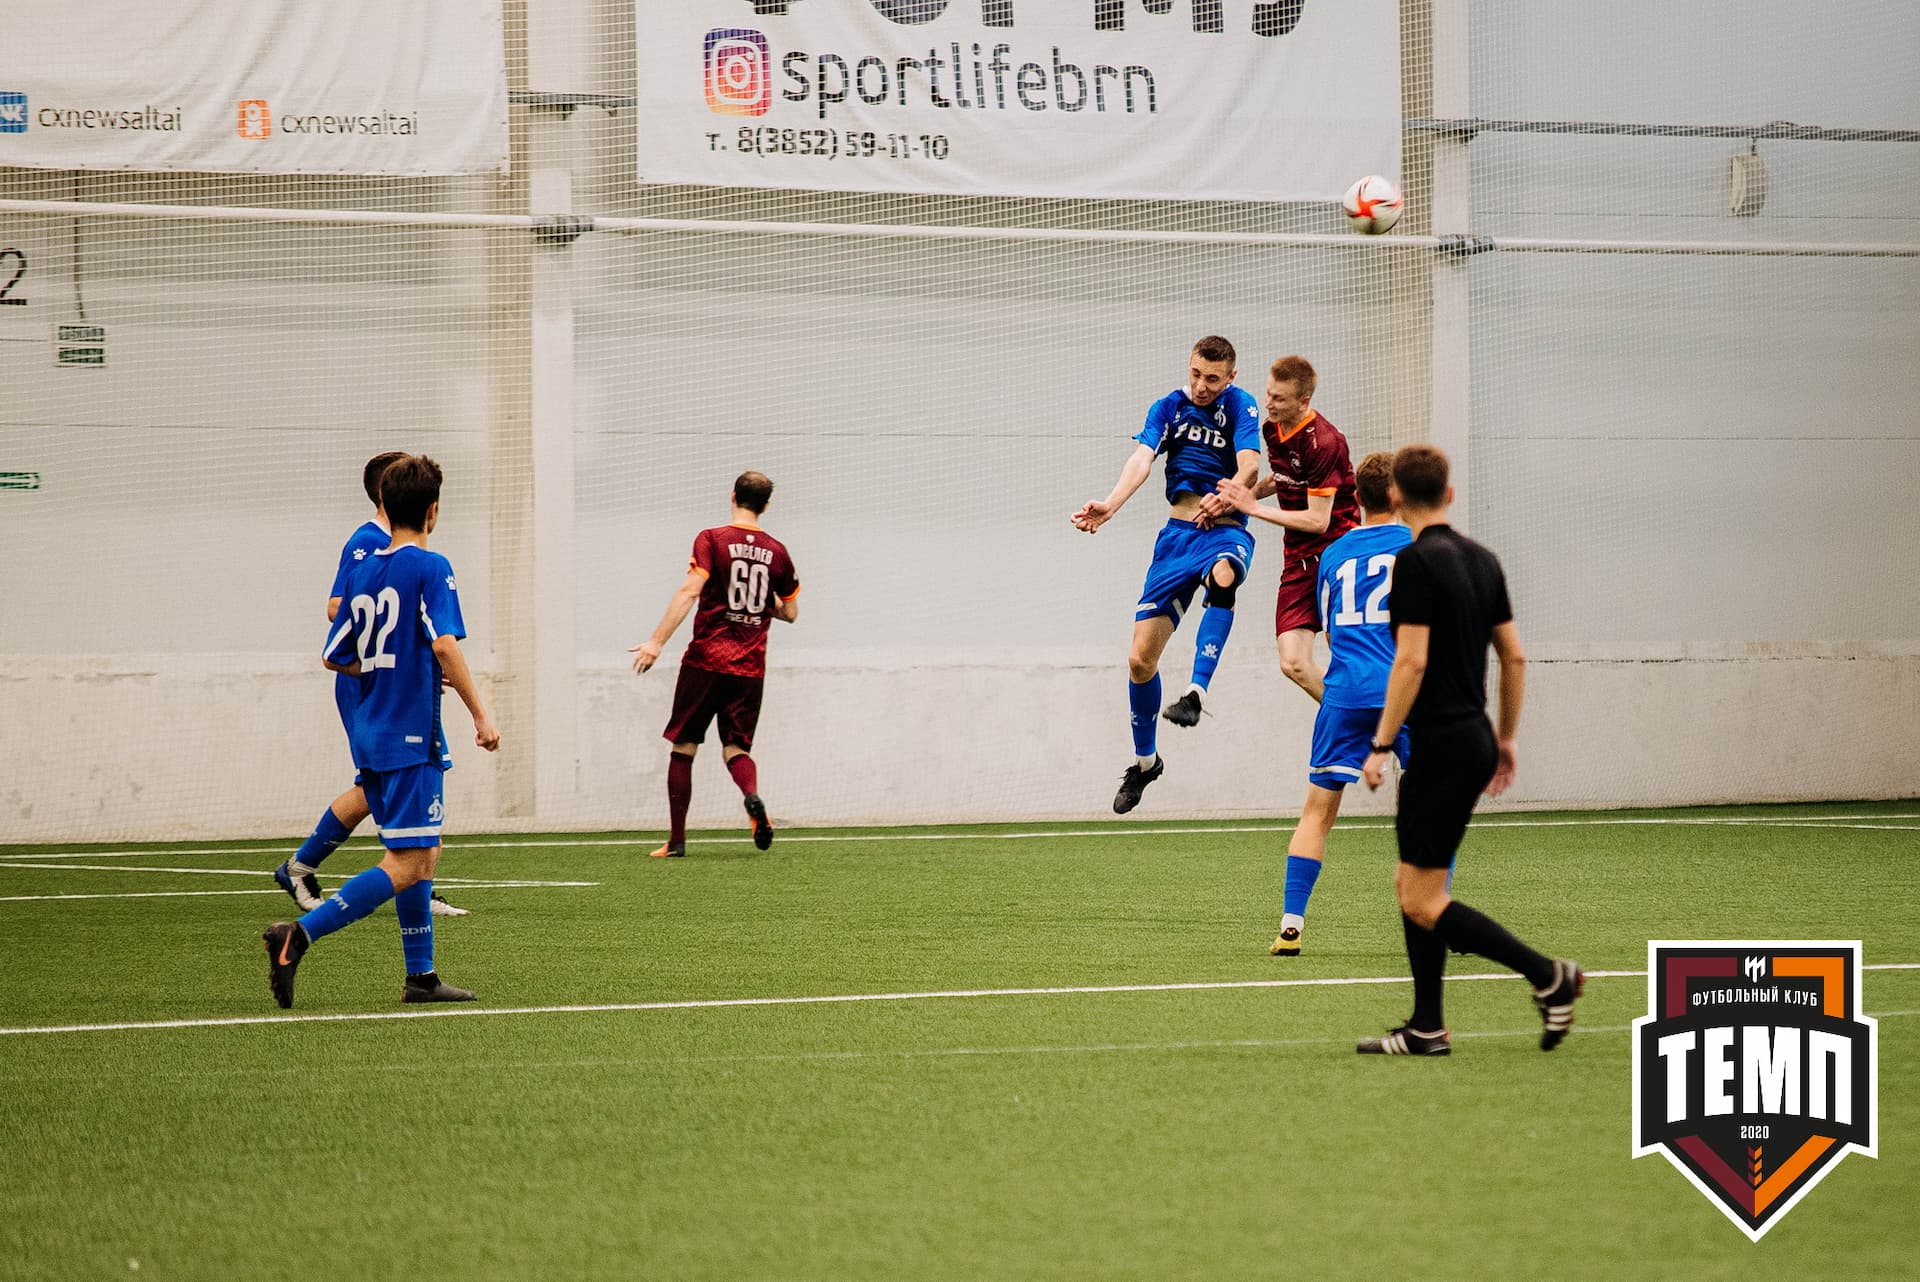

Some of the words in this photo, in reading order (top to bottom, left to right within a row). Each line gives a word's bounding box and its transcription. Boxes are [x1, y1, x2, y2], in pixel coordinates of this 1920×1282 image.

[782, 41, 1158, 119] sportlifebrn
[845, 131, 950, 161] 59-11-10
[728, 560, 769, 614] 60
[1335, 553, 1397, 626] 12
[350, 586, 400, 673] 22
